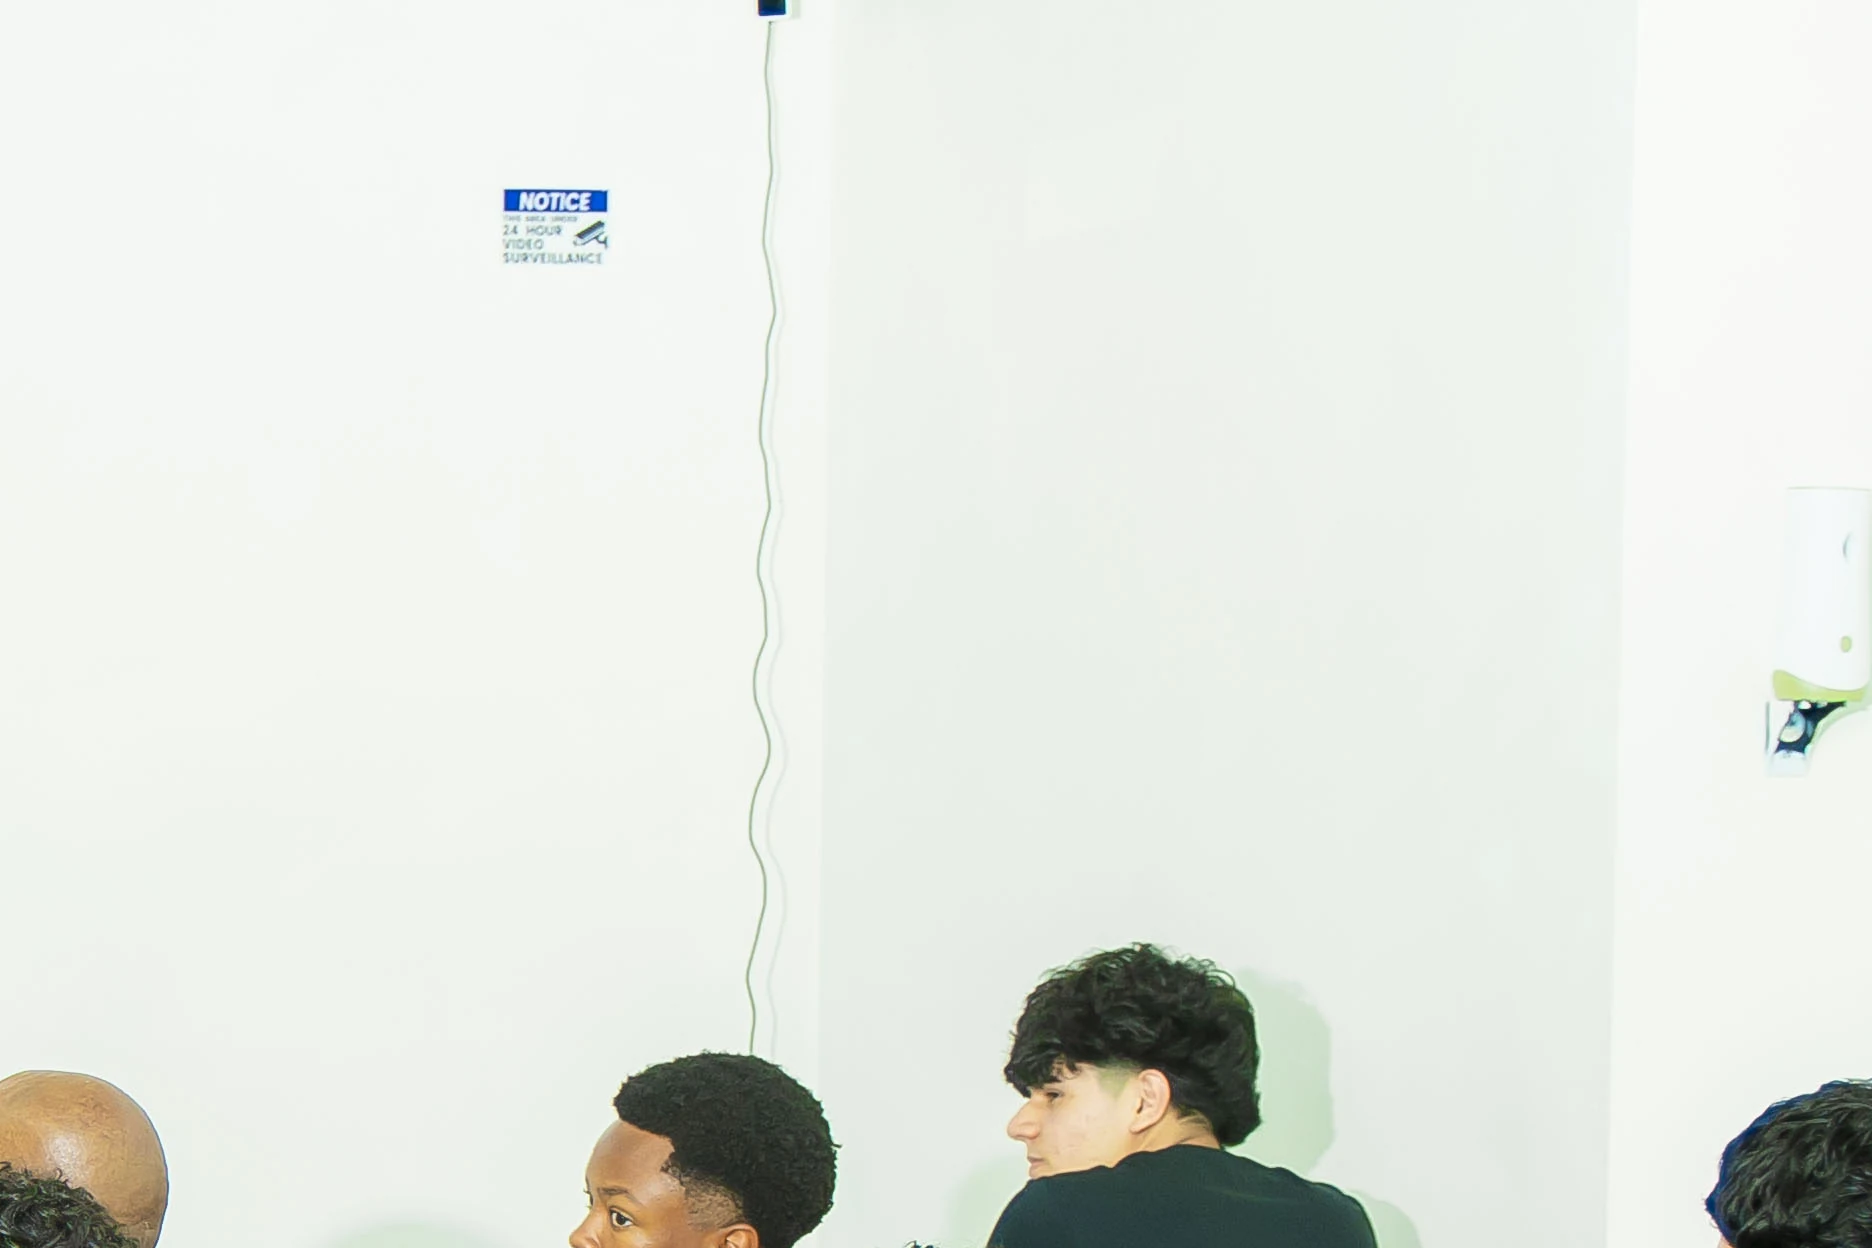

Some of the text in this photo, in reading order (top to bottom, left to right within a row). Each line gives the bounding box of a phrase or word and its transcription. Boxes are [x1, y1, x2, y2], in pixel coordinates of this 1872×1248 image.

[518, 191, 592, 211] NOTICE
[503, 225, 562, 235] 24 HOUR
[503, 239, 544, 249] VIDEO
[503, 253, 602, 264] SURVEILLANCE
